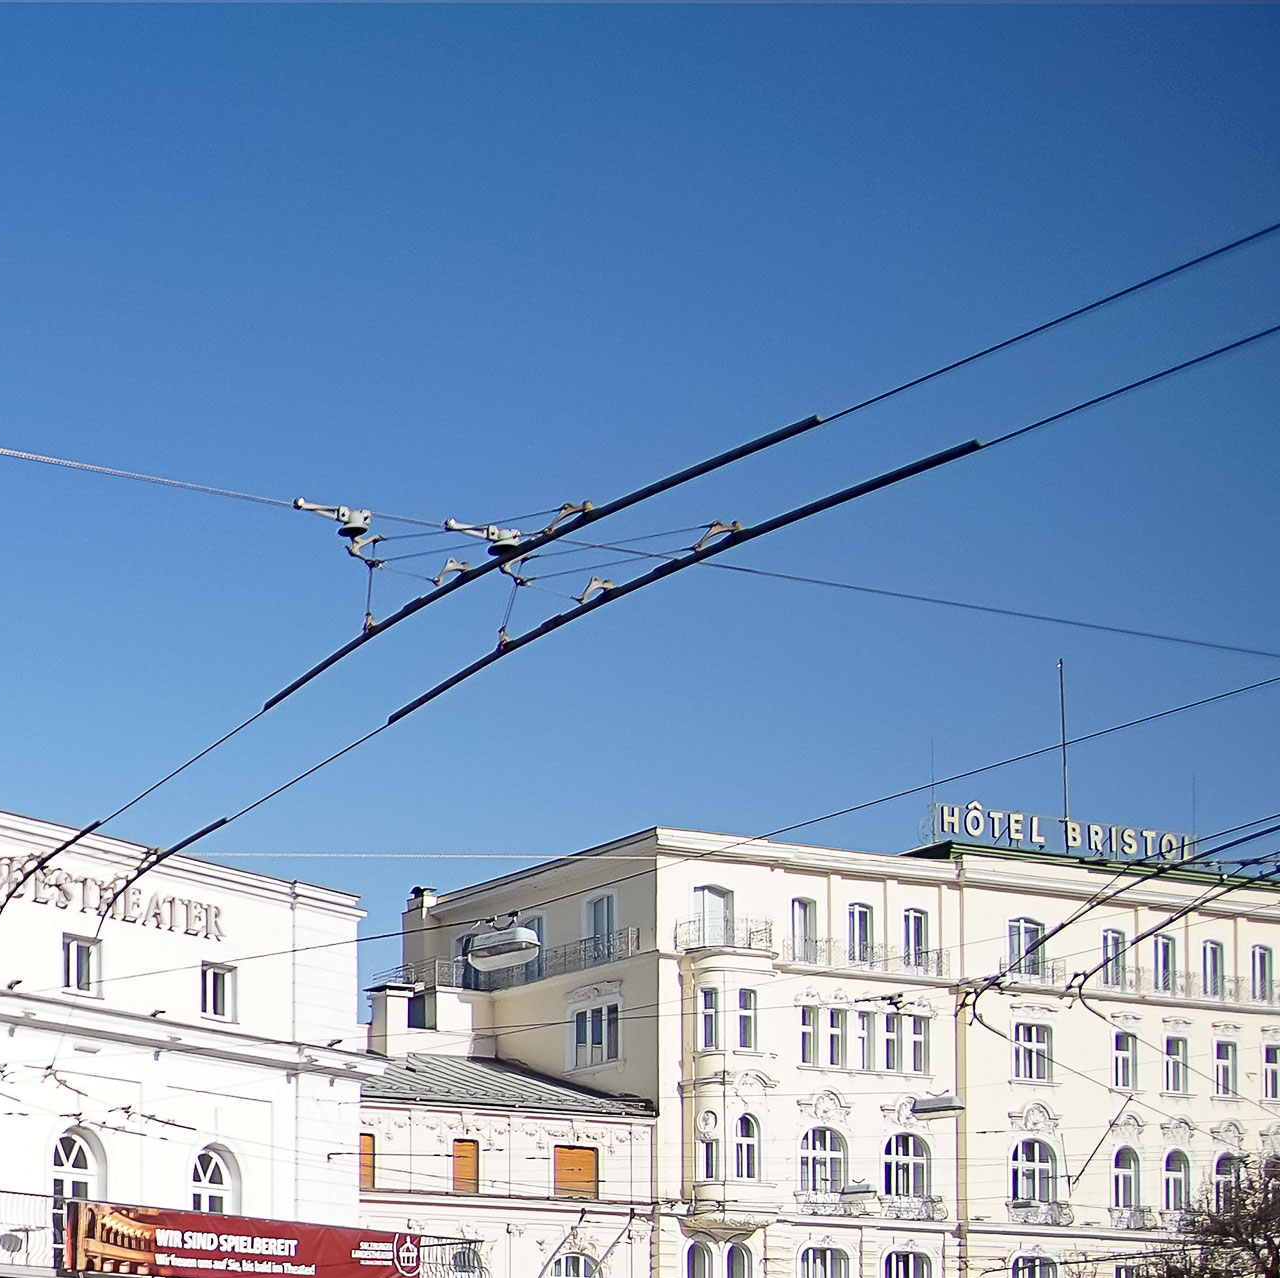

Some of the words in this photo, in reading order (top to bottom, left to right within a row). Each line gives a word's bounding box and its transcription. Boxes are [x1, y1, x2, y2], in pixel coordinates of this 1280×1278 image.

[940, 800, 1046, 845] HÔTEL
[1065, 819, 1194, 862] BRISTOL
[155, 1228, 183, 1248] WIR
[183, 1231, 218, 1251] SIND
[219, 1234, 298, 1256] SPIELBEREIT
[155, 1253, 170, 1266] Wir
[213, 1258, 227, 1270] auf
[242, 1260, 254, 1272] bis
[254, 1261, 272, 1273] bald
